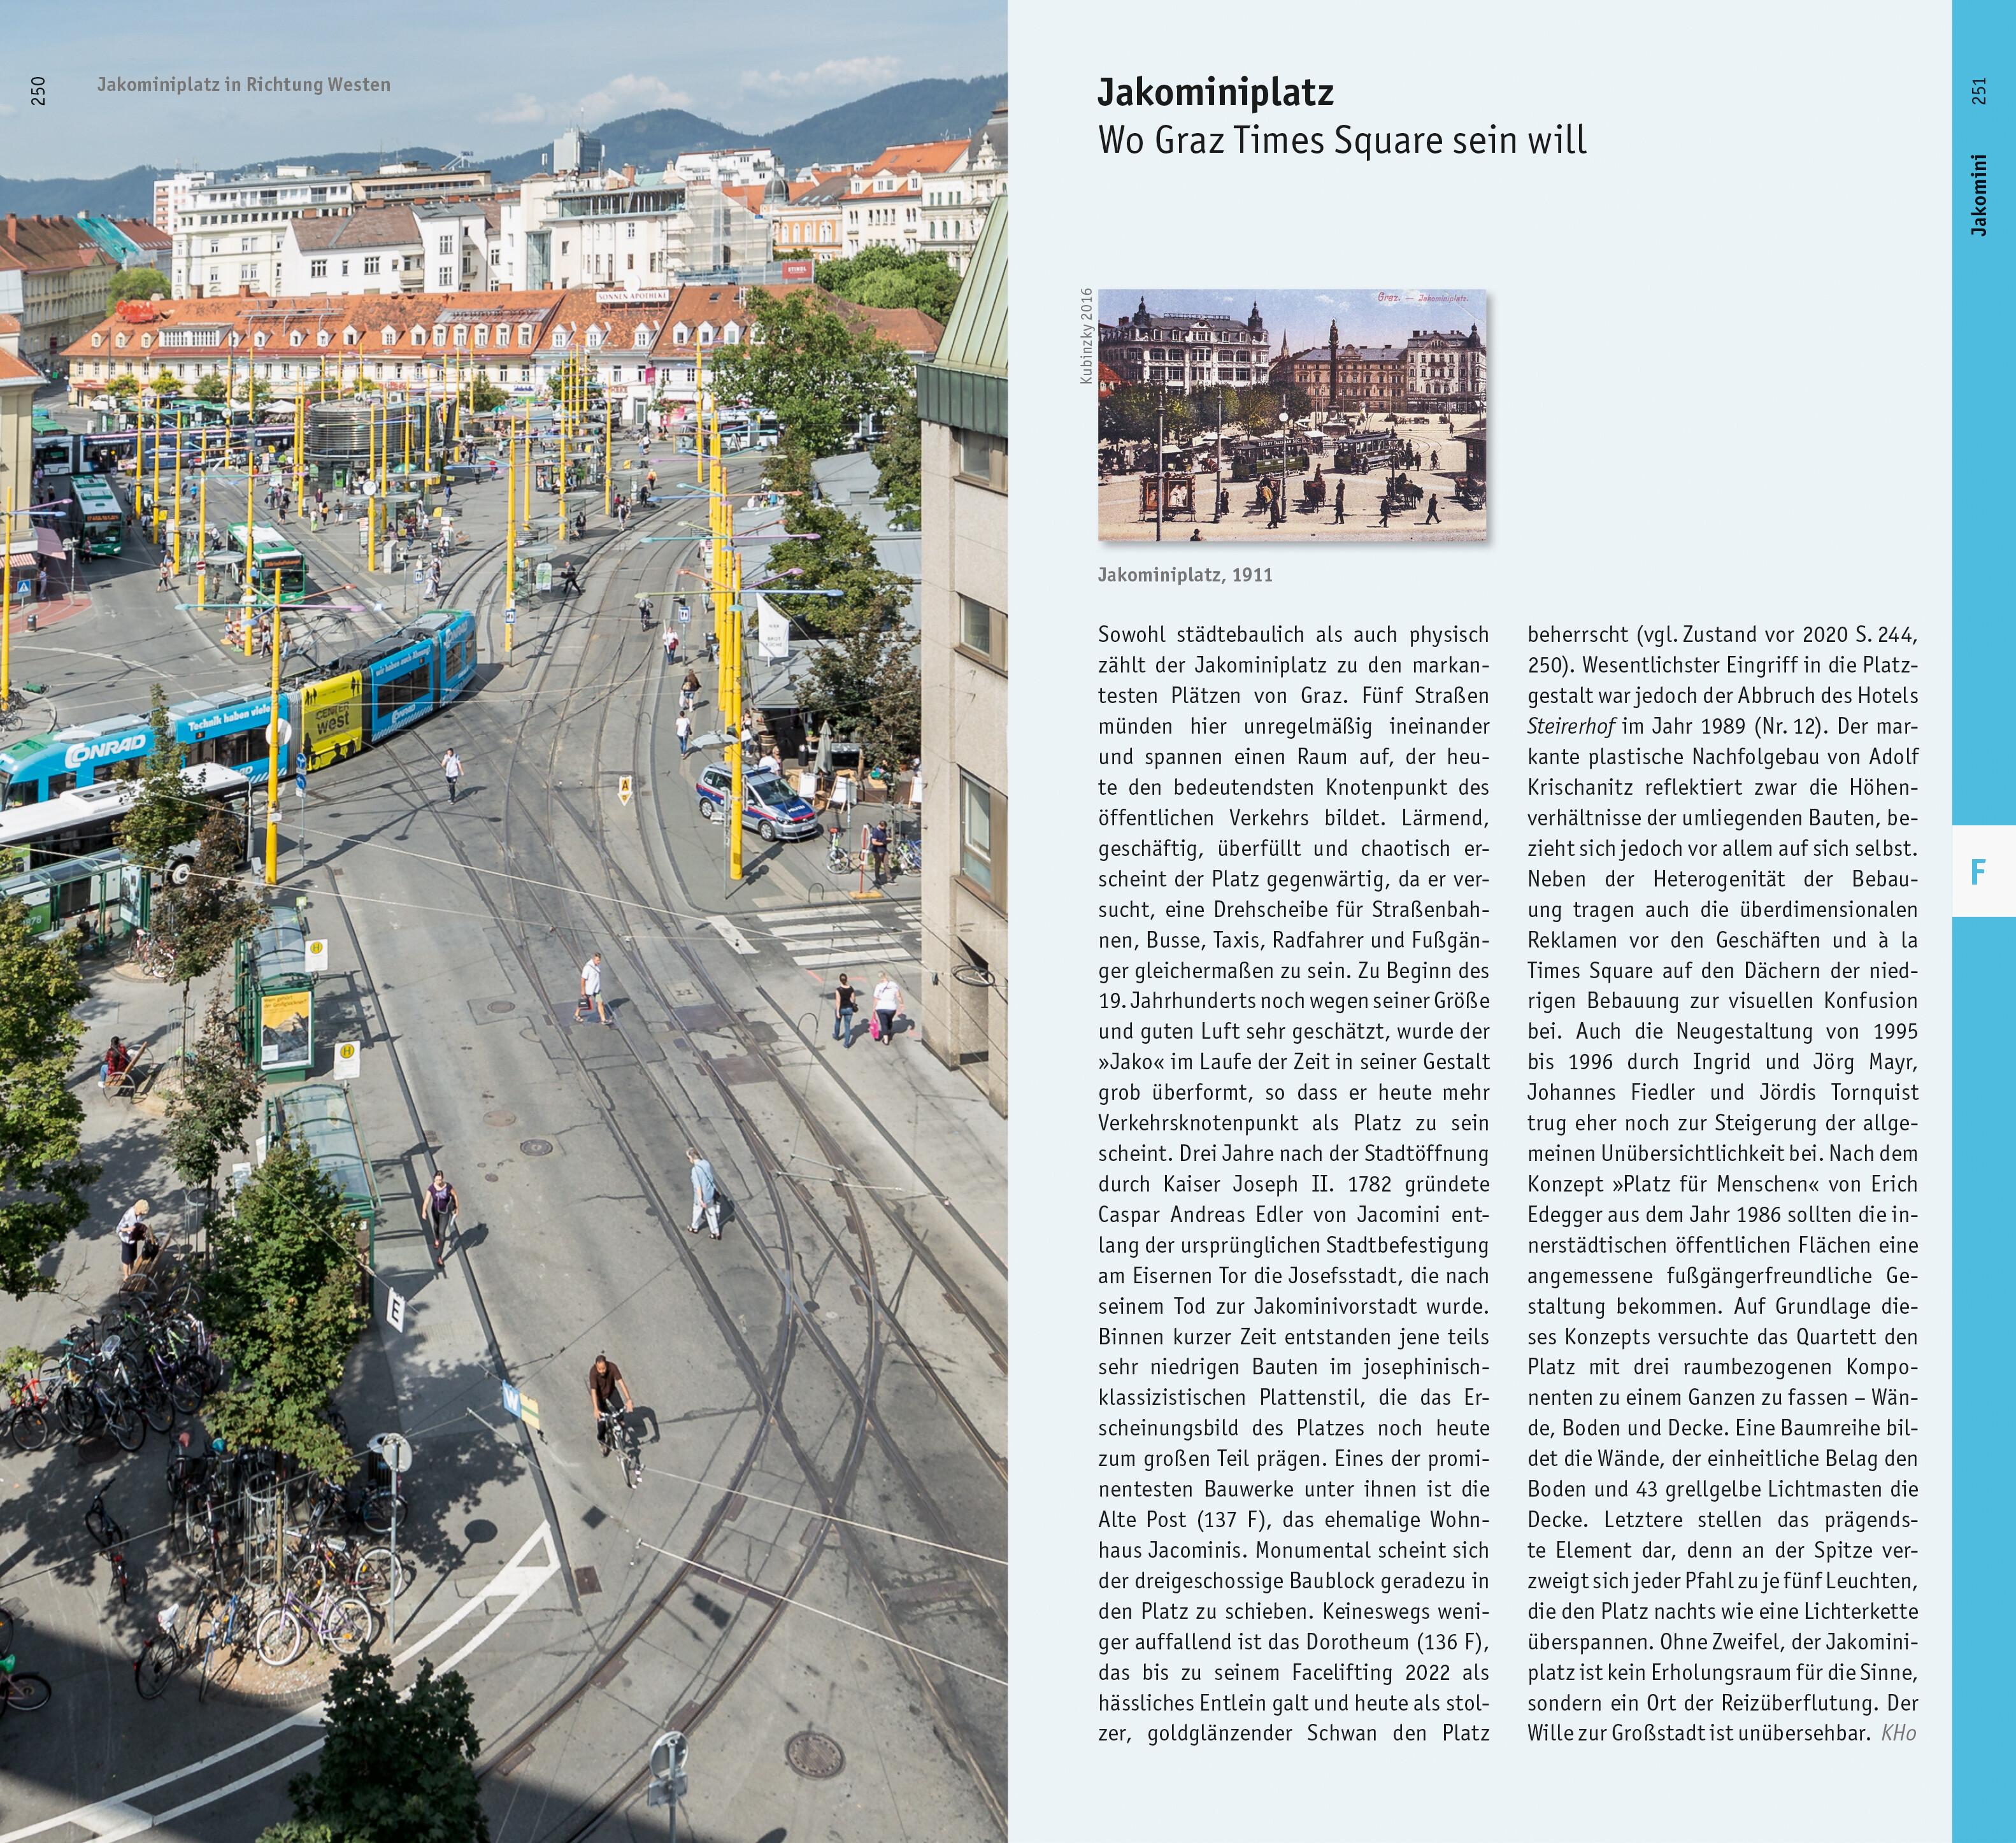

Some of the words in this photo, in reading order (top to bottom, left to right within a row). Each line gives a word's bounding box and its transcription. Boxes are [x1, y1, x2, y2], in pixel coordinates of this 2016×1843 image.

[1097, 76, 1334, 113] Jakominiplatz
[1972, 78, 1985, 104] 251
[1099, 125, 1143, 153] Wo
[1156, 125, 1224, 153] Graz
[1234, 124, 1324, 153] Times
[1335, 125, 1442, 161] Square
[1454, 124, 1515, 153] sein
[1528, 124, 1587, 153] will
[1971, 155, 1986, 236] Jakomini
[1081, 288, 1092, 320] 2016
[1378, 292, 1401, 301] Graz.
[1418, 294, 1468, 303] Jakominiplatz.
[1080, 325, 1095, 383] Kubinzky
[1098, 567, 1226, 585] Jakominiplatz,
[1233, 567, 1272, 581] 1911
[1099, 625, 1166, 642] Sowohl
[1177, 625, 1303, 642] städtebaulich
[1317, 625, 1342, 642] als
[1354, 625, 1396, 642] auch
[1410, 625, 1488, 647] physisch
[1529, 625, 1629, 642] beherrscht
[1638, 625, 1677, 647] (vgl.
[1684, 625, 1756, 642] Zustand
[1765, 630, 1794, 642] vor
[1804, 627, 1847, 642] 2020
[1856, 625, 1871, 642] S.
[1879, 627, 1917, 645] 244,
[376, 665, 385, 676] wir
[385, 661, 400, 672] haben
[401, 653, 412, 665] auch
[188, 714, 222, 732] Technik
[224, 710, 250, 723] haben
[250, 704, 271, 716] viele
[315, 701, 350, 720] CENTER
[392, 703, 416, 724] CONRAD
[317, 710, 350, 735] west
[1099, 717, 1171, 734] münden
[1192, 717, 1227, 734] hier
[1245, 717, 1371, 739] unregelmäßig
[1390, 717, 1490, 734] ineinander
[1527, 717, 1618, 738] Steirerhof
[1622, 717, 1643, 734] im
[1652, 717, 1692, 734] Jahr
[1702, 718, 1745, 734] 1989
[1755, 716, 1787, 739] (Nr.
[1794, 716, 1827, 739] 12).
[1839, 717, 1868, 734] Der
[1877, 722, 1918, 734] mar-
[64, 734, 147, 769] CONRAD
[622, 779, 629, 791] A
[1099, 809, 1213, 825] öffentlichen
[1229, 809, 1308, 825] Verkehrs
[1326, 809, 1385, 825] bildet.
[1403, 809, 1488, 829] Lärmend,
[1529, 870, 1585, 886] Neben
[1606, 870, 1634, 886] der
[1655, 870, 1785, 892] Heterogenität
[1805, 870, 1833, 886] der
[1854, 870, 1918, 886] Bebau-
[1972, 859, 1985, 885] F
[1099, 900, 1154, 920] sucht,
[1166, 900, 1204, 917] eine
[1215, 900, 1327, 917] Drehscheibe
[1336, 900, 1363, 917] für
[1373, 900, 1489, 917] Straßenbah-
[1529, 1053, 1554, 1069] bis
[1569, 1054, 1612, 1069] 1996
[1628, 1053, 1678, 1069] durch
[1694, 1053, 1750, 1074] Ingrid
[1767, 1053, 1799, 1069] und
[1813, 1053, 1854, 1074] Jörg
[1870, 1053, 1917, 1074] Mayr,
[1098, 1114, 1299, 1135] Verkehrsknotenpunkt
[1313, 1114, 1338, 1130] als
[1355, 1114, 1401, 1130] Platz
[1416, 1119, 1436, 1130] zu
[1452, 1114, 1488, 1130] sein
[1099, 1175, 1149, 1192] durch
[1165, 1175, 1220, 1192] Kaiser
[1233, 1175, 1297, 1197] Joseph
[1312, 1175, 1333, 1192] II.
[1349, 1176, 1390, 1192] 1782
[1406, 1175, 1489, 1197] gründete
[1529, 1175, 1604, 1197] Konzept
[1613, 1175, 1670, 1192] »Platz
[1680, 1175, 1707, 1192] für
[1718, 1175, 1819, 1192] Menschen«
[1829, 1180, 1860, 1192] von
[1873, 1175, 1917, 1192] Erich
[1528, 1272, 1652, 1288] angemessene
[1667, 1267, 1871, 1288] fußgängerfreundliche
[1887, 1267, 1918, 1283] Ge-
[392, 1298, 401, 1323] E
[504, 1386, 519, 1412] W
[1529, 1480, 1585, 1497] Boden
[1596, 1480, 1627, 1497] und
[1636, 1481, 1657, 1497] 43
[1666, 1480, 1761, 1502] grellgelbe
[1769, 1480, 1881, 1497] Lichtmasten
[1891, 1480, 1918, 1497] die
[1099, 1511, 1136, 1527] Alte
[1148, 1511, 1187, 1527] Post
[1198, 1510, 1236, 1532] (137
[1249, 1510, 1271, 1532] F),
[1283, 1511, 1313, 1527] das
[1326, 1511, 1420, 1532] ehemalige
[1431, 1511, 1489, 1527] Wohn-
[1529, 1633, 1653, 1654] überspannen.
[1661, 1633, 1707, 1649] Ohne
[1713, 1633, 1784, 1653] Zweifel,
[1792, 1633, 1821, 1649] der
[1826, 1633, 1918, 1649] Jakomini-
[1099, 1729, 1131, 1744] zer,
[1148, 1724, 1292, 1746] goldglänzender
[1308, 1724, 1376, 1740] Schwan
[1394, 1724, 1426, 1740] den
[1444, 1724, 1489, 1740] Platz
[1528, 1724, 1573, 1740] Wille
[1578, 1729, 1607, 1740] zur
[1612, 1724, 1706, 1740] Großstadt
[1710, 1724, 1734, 1740] ist
[1740, 1724, 1870, 1740] unübersehbar.
[1882, 1724, 1916, 1740] KHo
